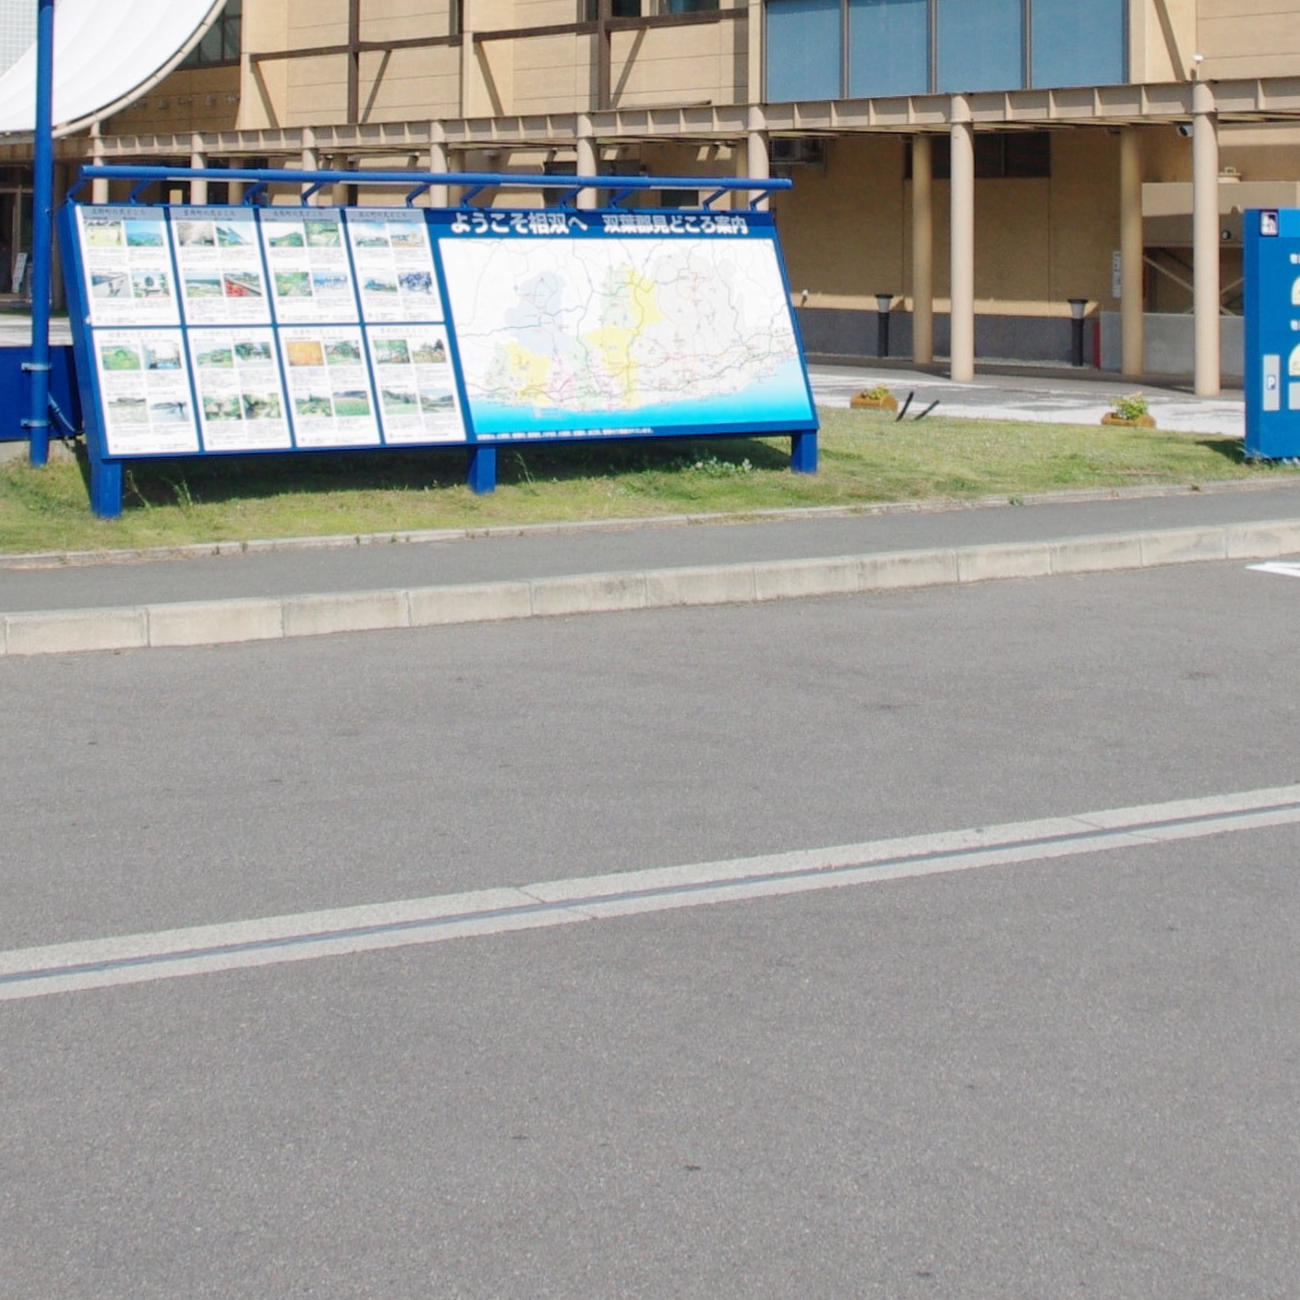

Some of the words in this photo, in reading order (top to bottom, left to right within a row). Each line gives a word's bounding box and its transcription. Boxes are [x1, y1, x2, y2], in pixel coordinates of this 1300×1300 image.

[450, 212, 588, 235] ようこそ相双へ
[602, 214, 749, 236] 双葉郡見どころ案内
